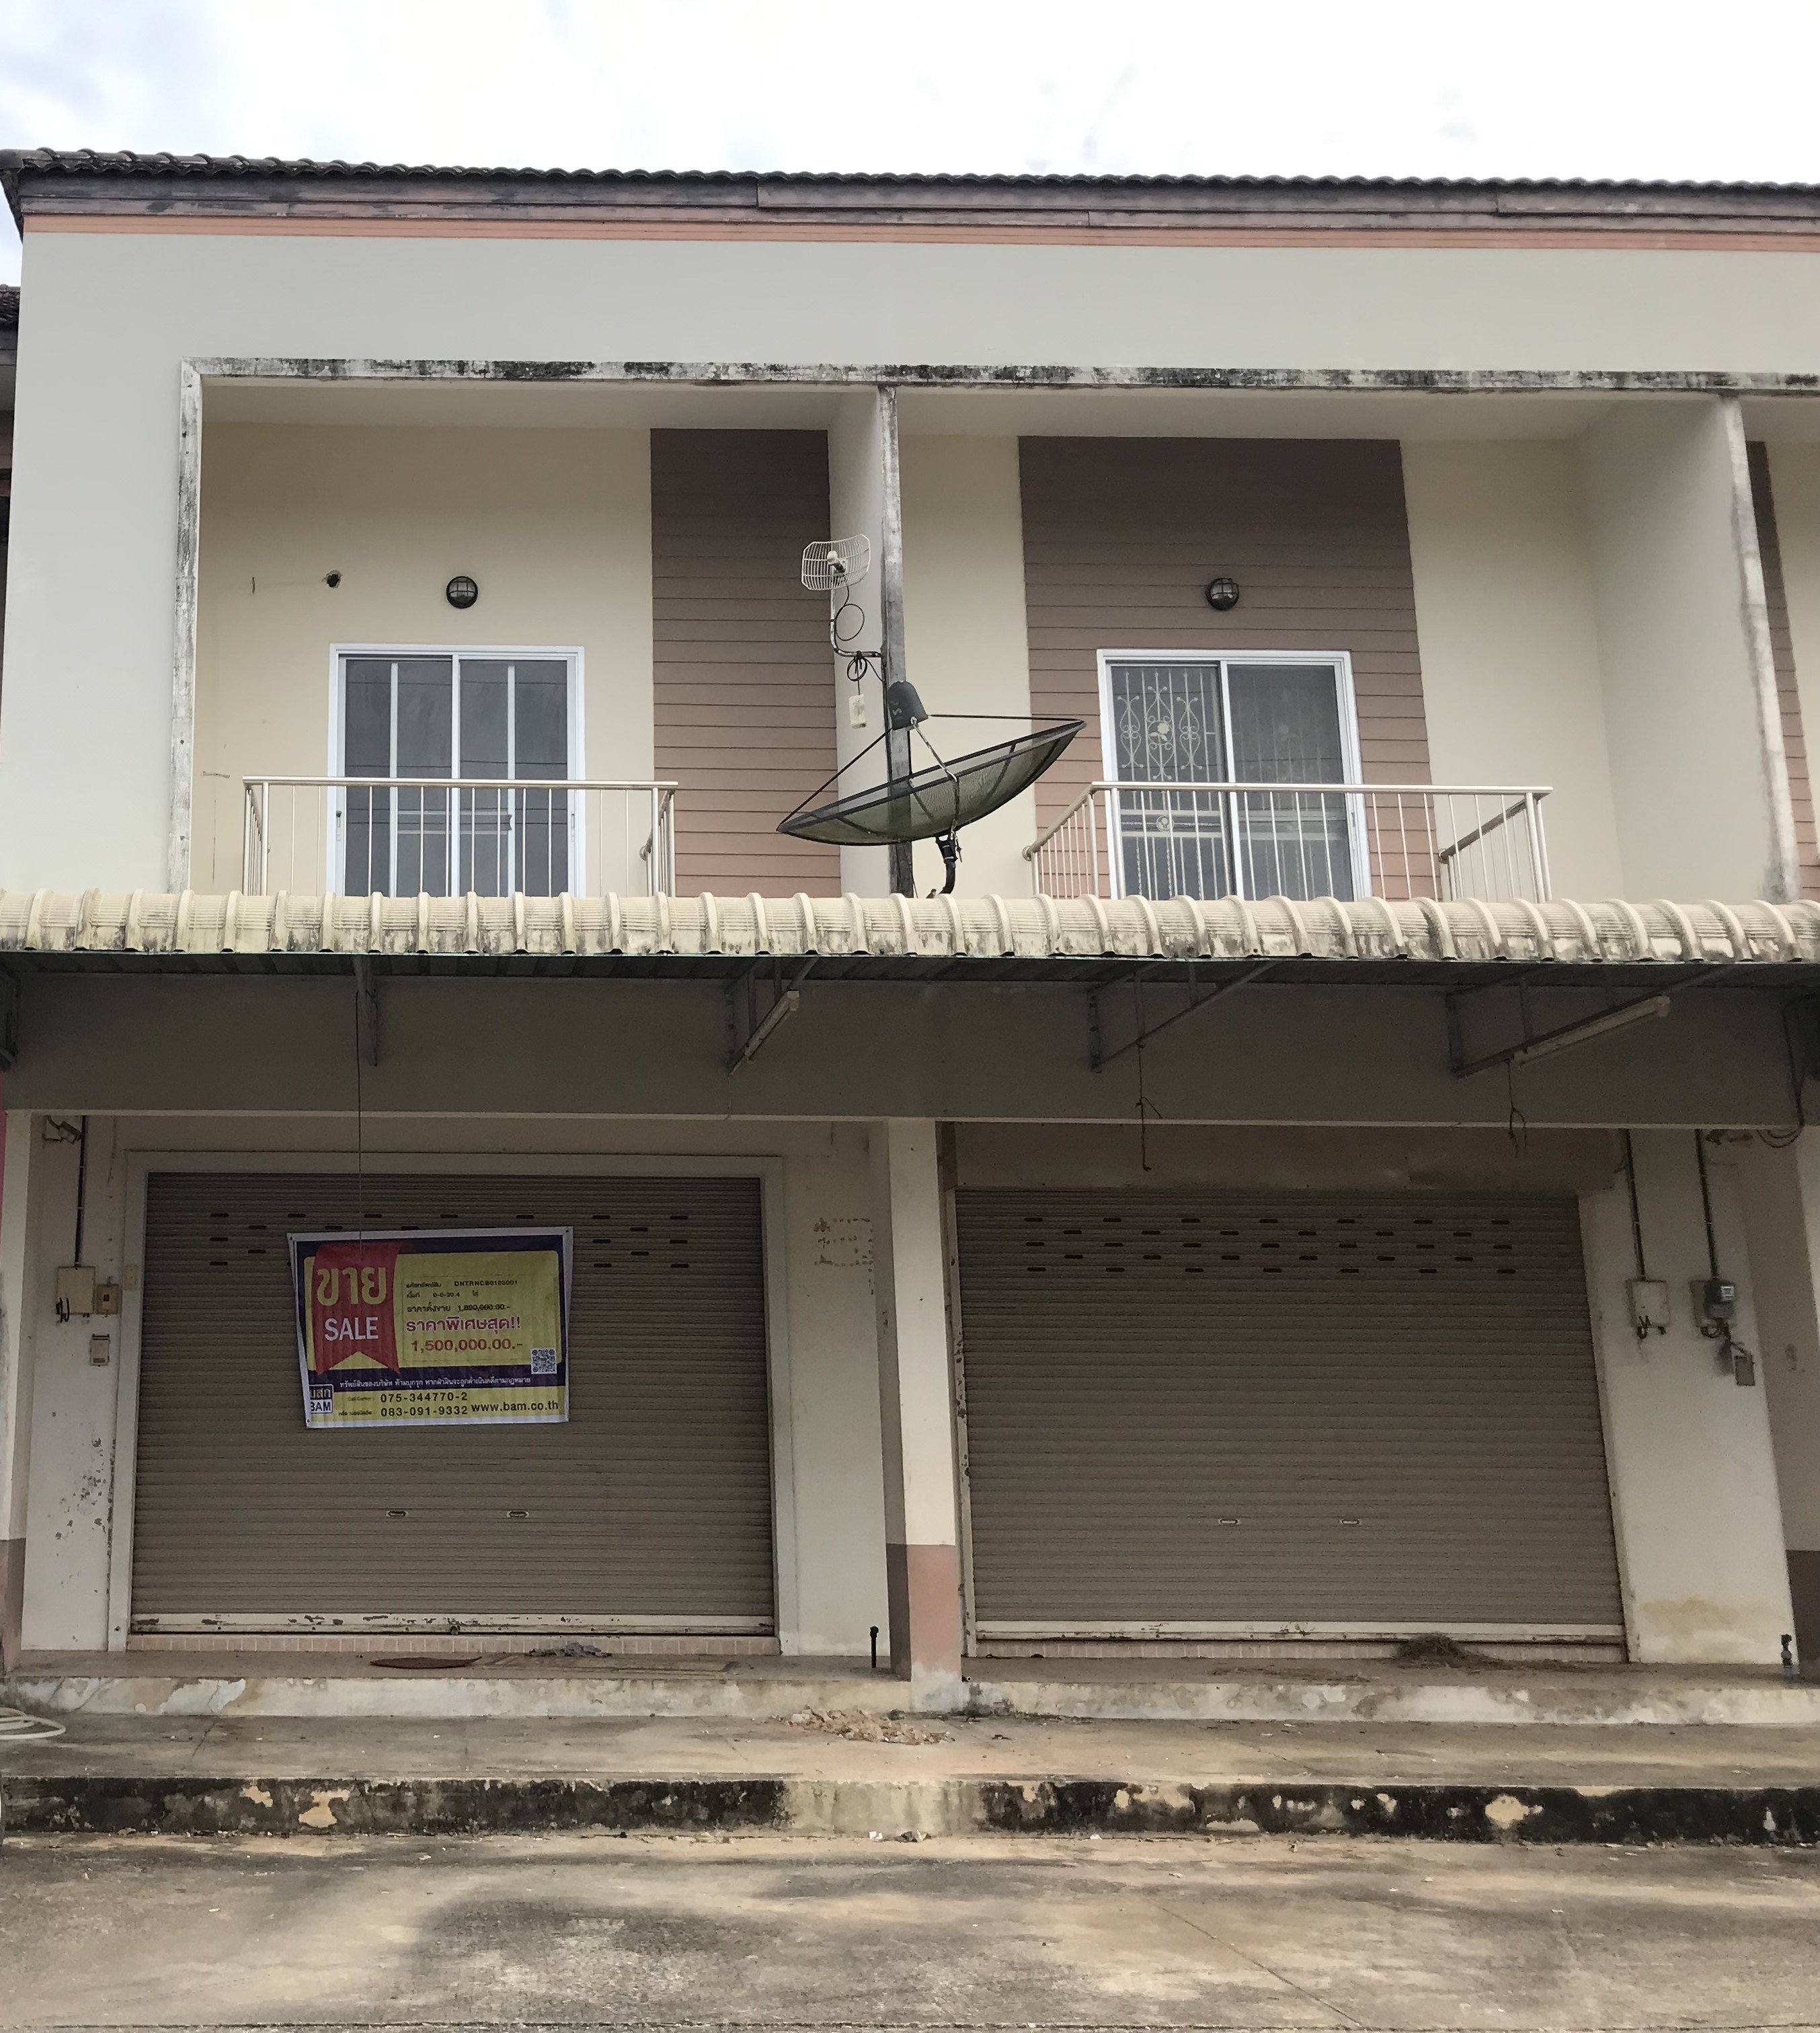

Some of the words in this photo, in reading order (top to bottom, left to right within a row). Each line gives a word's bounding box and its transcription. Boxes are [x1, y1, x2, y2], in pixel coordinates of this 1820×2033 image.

[317, 1267, 387, 1306] ขาย
[407, 1302, 451, 1312] ราคาตั้งขาย
[324, 1316, 379, 1341] SALE
[406, 1316, 520, 1334] ราคาพิเศษสุด!!
[411, 1339, 523, 1353] 1,500,000.00.-
[340, 1380, 393, 1388] ทรัพย์สินของบริษัท
[395, 1380, 423, 1388] ห้ามบุกรุก
[381, 1392, 467, 1402] 075-344770-2
[311, 1401, 331, 1412] BAM
[381, 1406, 467, 1417] 083-091-9332
[471, 1400, 559, 1412] www.bam.co.th
